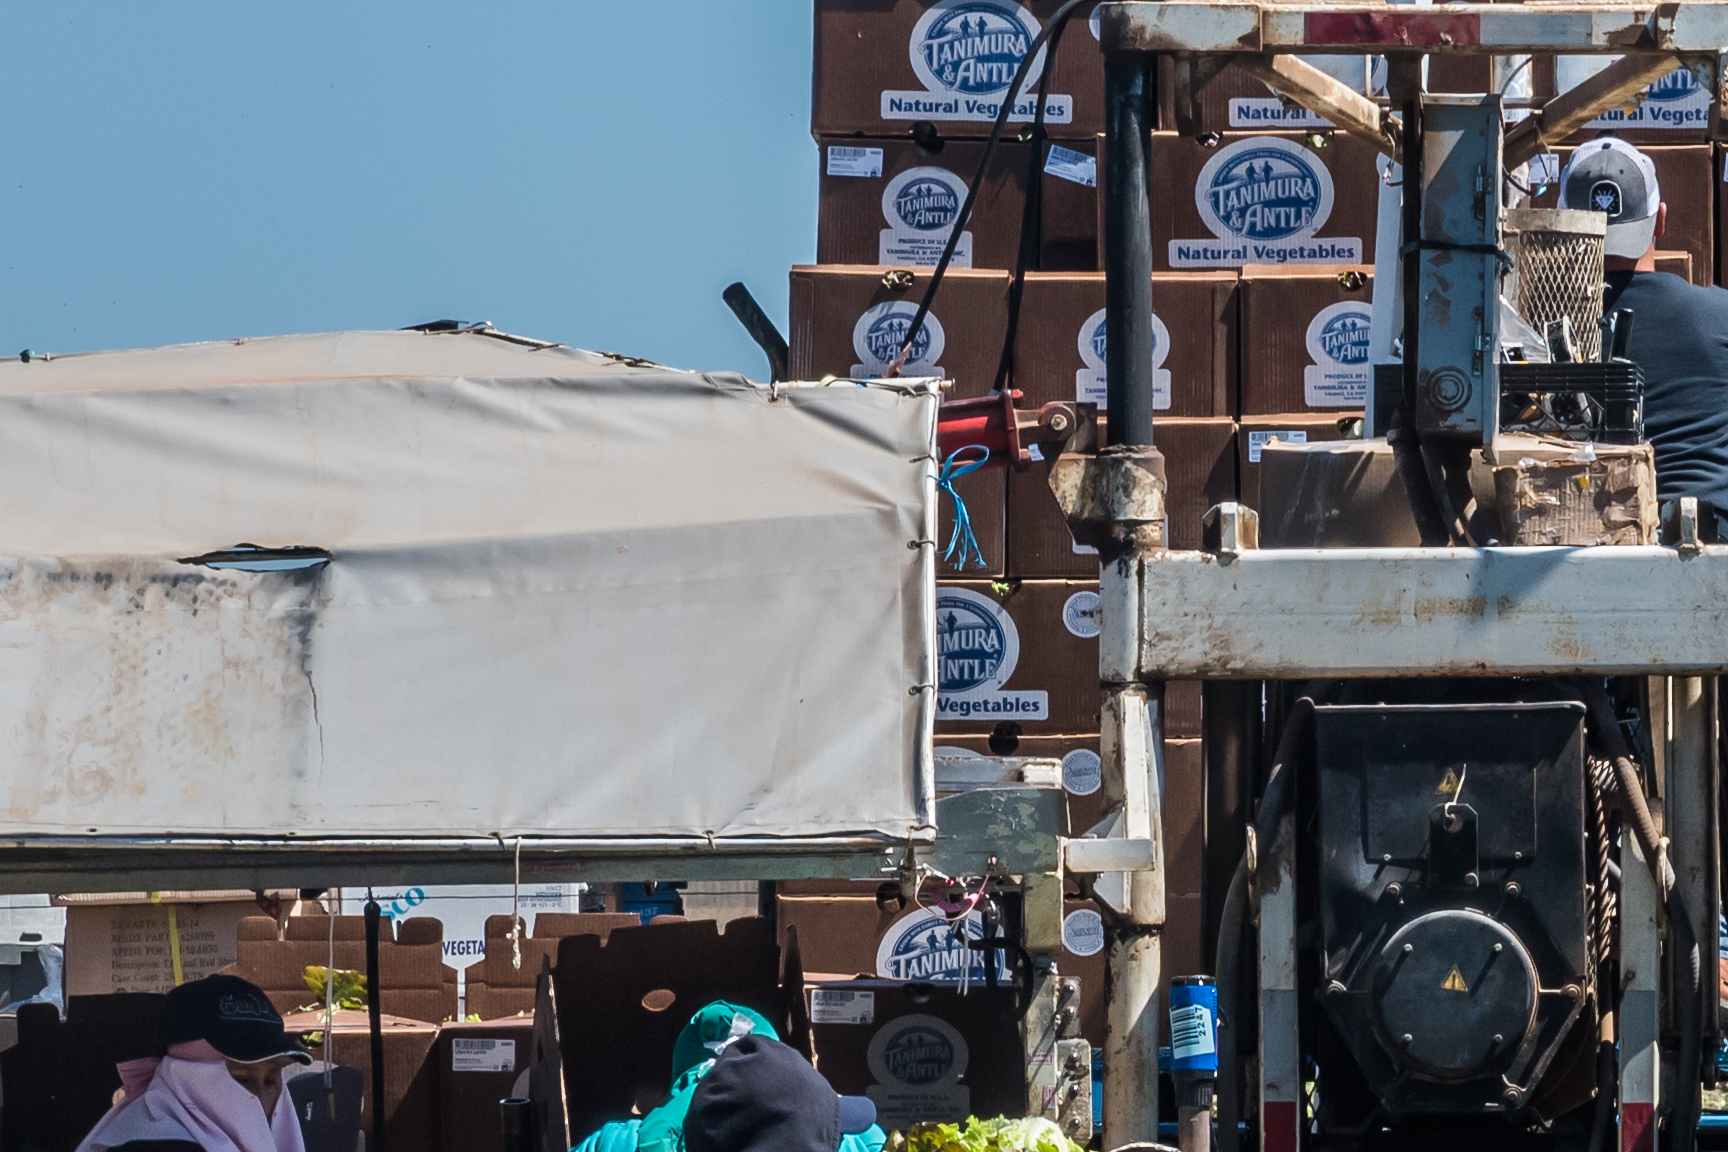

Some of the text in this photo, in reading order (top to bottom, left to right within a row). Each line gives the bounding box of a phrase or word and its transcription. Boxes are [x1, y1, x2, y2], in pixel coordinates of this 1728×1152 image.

[918, 33, 1028, 70] TANIMURA
[942, 64, 955, 83] &
[889, 98, 1065, 119] Natural Vegtabes
[1237, 105, 1307, 120] Natural
[894, 196, 955, 216] TANIMURA
[1205, 177, 1316, 217] TANIMURA
[1229, 204, 1313, 235] & ANTLE
[1177, 244, 1355, 262] Natural Vegetables
[864, 330, 928, 351] TANIMRA
[883, 344, 927, 361] ATLE
[937, 697, 1040, 717] Vegetables
[442, 939, 486, 957] VEGETA
[1194, 1006, 1206, 1038] 2247
